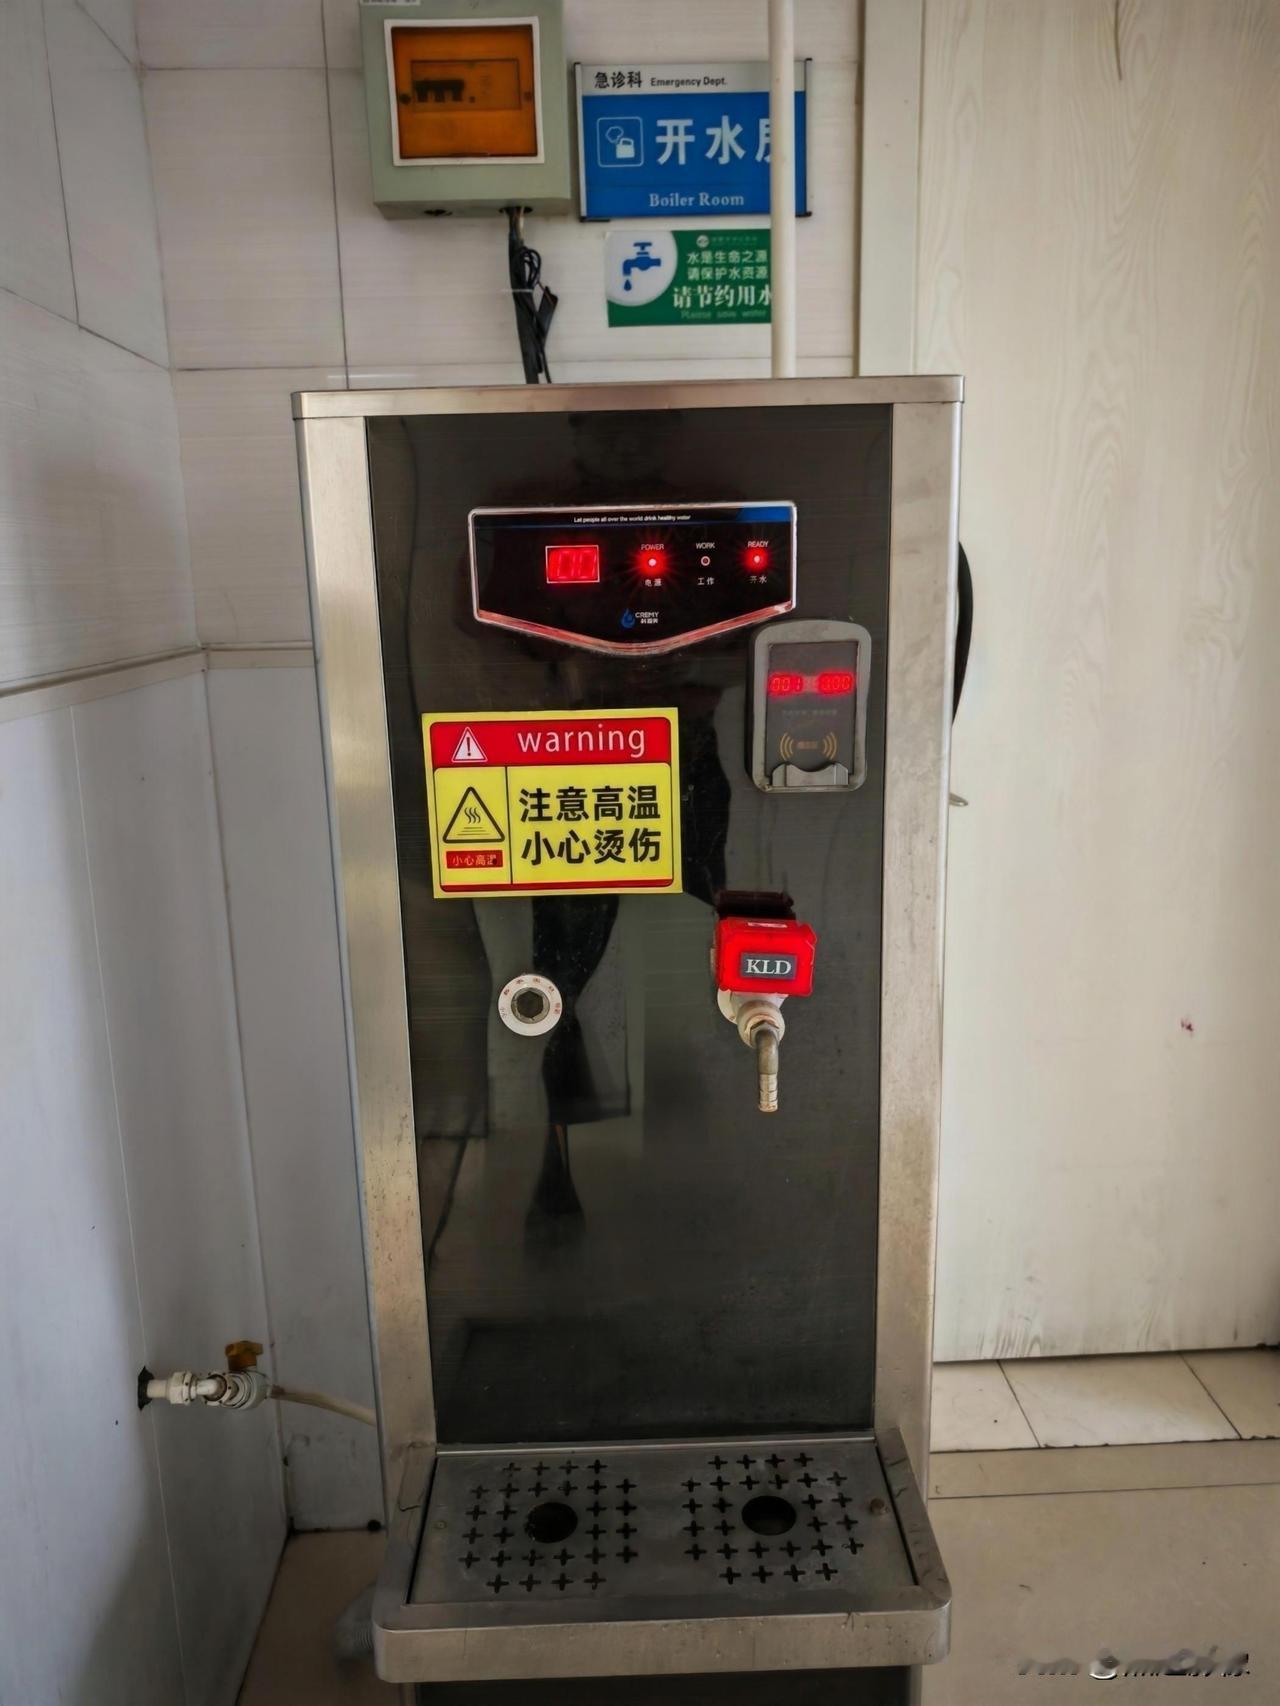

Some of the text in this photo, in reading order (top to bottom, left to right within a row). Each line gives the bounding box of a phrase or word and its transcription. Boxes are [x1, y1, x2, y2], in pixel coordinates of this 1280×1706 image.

[594, 71, 643, 89] 急诊科
[650, 76, 728, 87] Emergency Dept.
[649, 192, 745, 207] Boiler Room
[686, 250, 768, 265] 水是生命之源
[687, 266, 768, 281] 请保护水资源
[658, 514, 676, 522] healthy
[748, 540, 769, 548] READY
[697, 577, 715, 586] 工作
[750, 575, 768, 584] 开水
[635, 611, 660, 619] CREMY
[517, 723, 646, 758] warning
[519, 785, 661, 823] 注意高温
[521, 827, 661, 866] 小心烫伤
[745, 958, 792, 975] KLD
